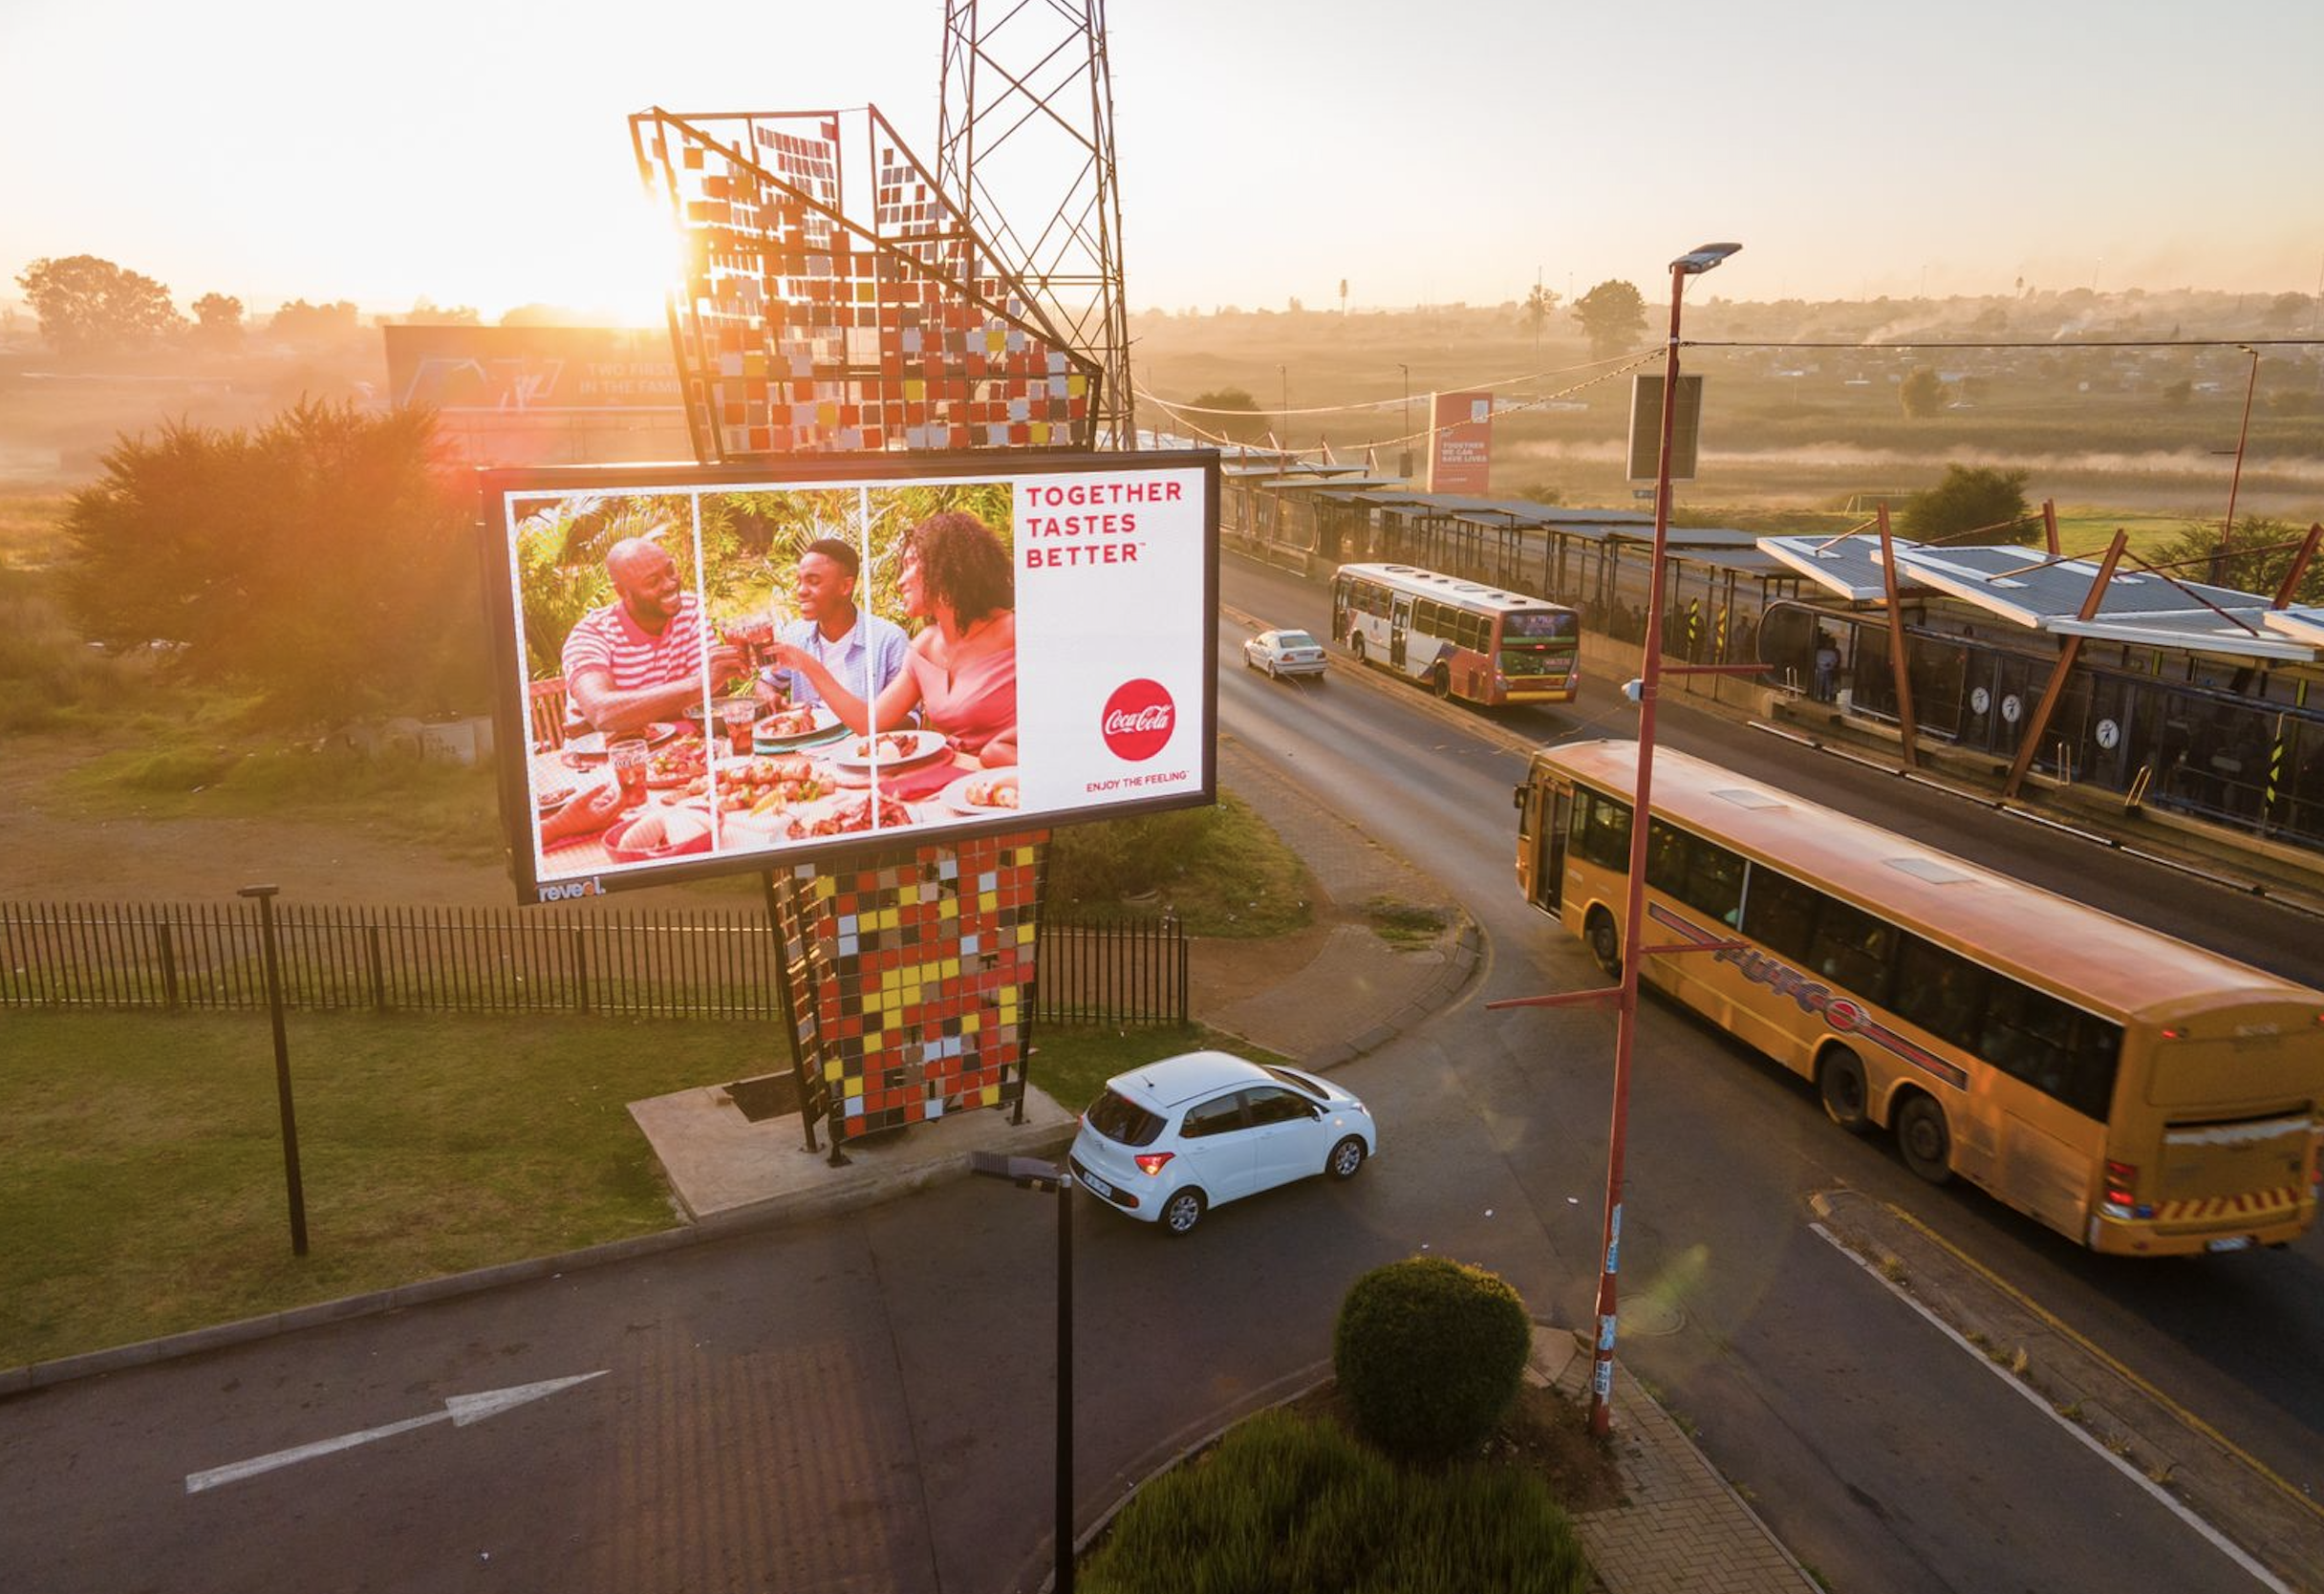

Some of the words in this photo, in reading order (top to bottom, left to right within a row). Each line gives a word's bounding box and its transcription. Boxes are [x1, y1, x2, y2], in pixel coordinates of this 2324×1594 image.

[1025, 482, 1181, 507] TOGETHER
[1026, 514, 1136, 538] TASTES
[1086, 780, 1121, 793] ENJOY
[1124, 777, 1144, 788] THE
